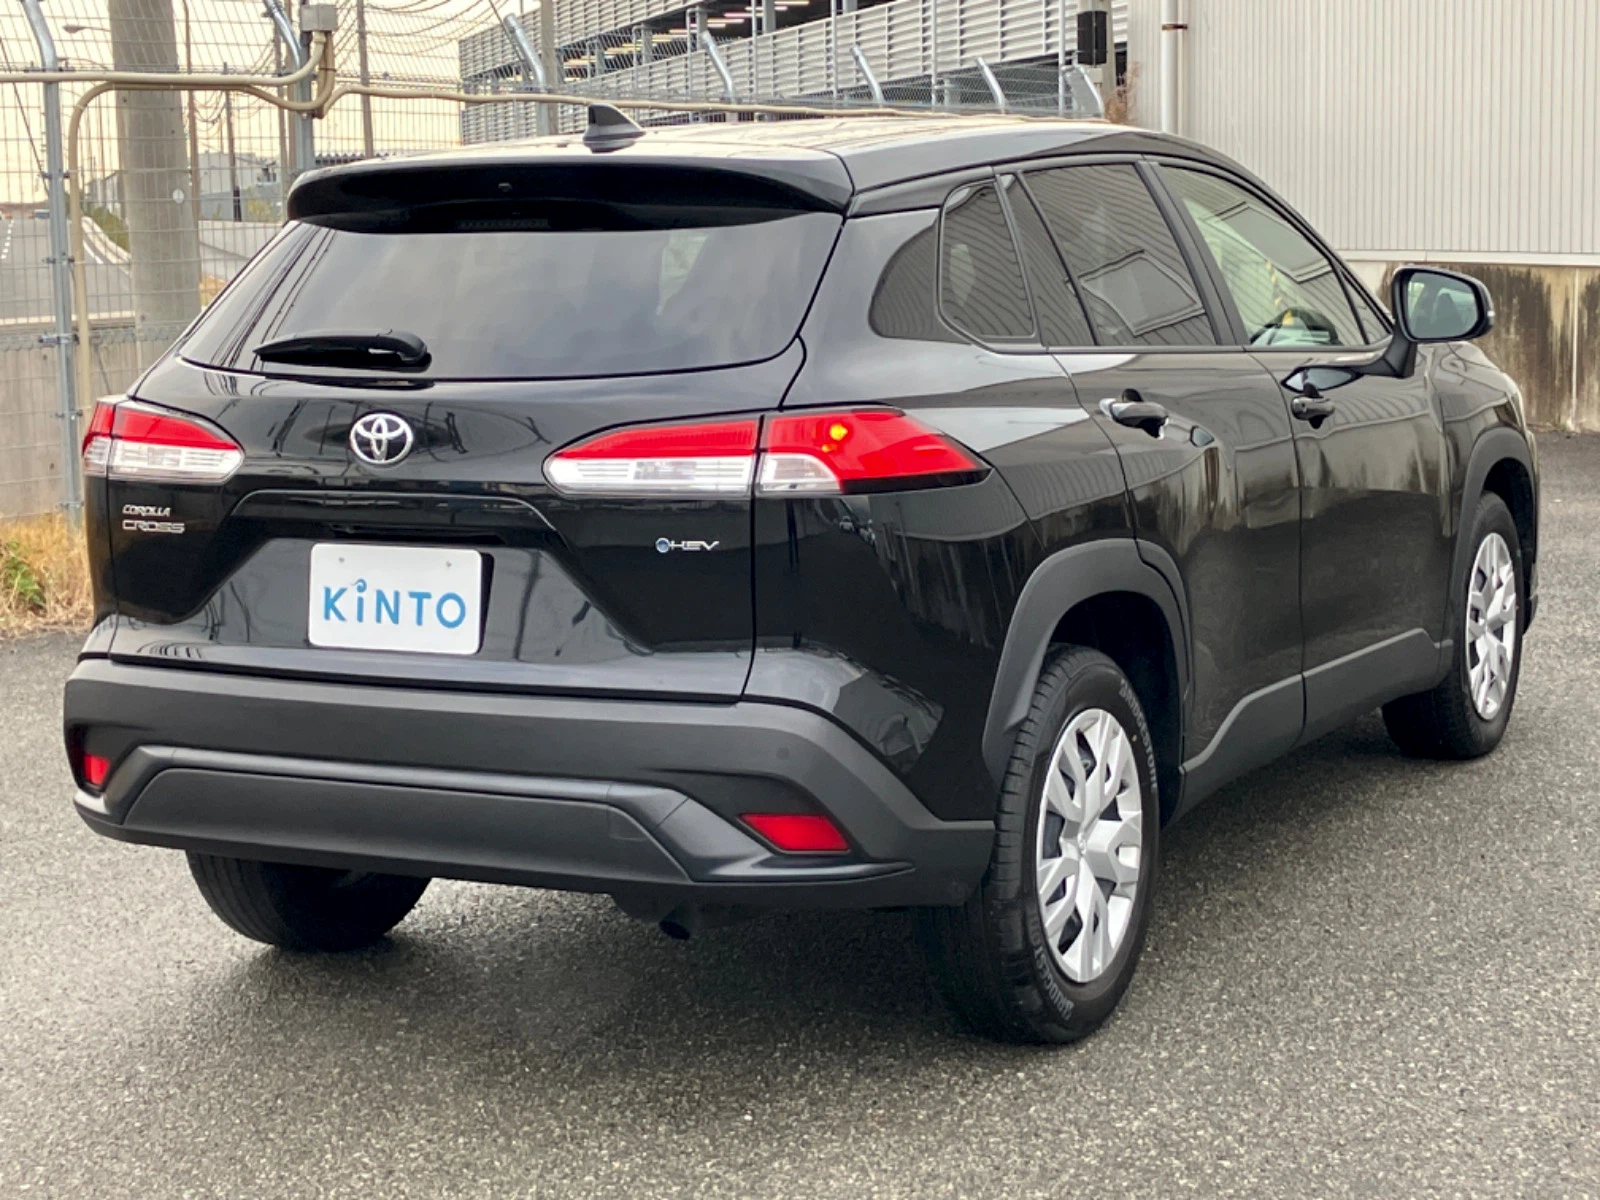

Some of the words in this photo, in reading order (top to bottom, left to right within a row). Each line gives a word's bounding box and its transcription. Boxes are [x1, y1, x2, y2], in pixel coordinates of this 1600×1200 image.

[122, 504, 171, 517] COROLLA
[122, 519, 185, 534] CROSS
[669, 539, 720, 552] HEV
